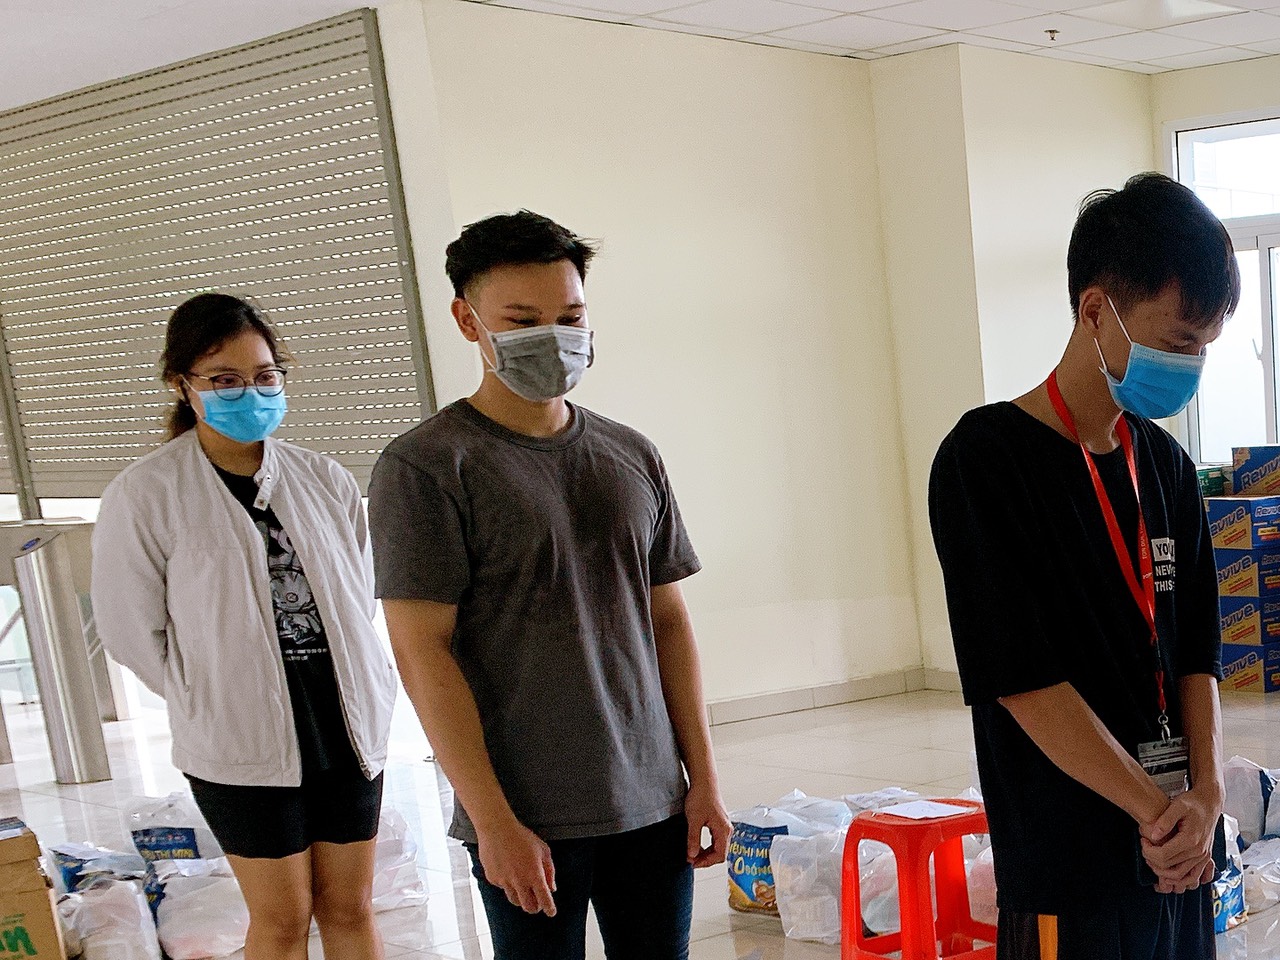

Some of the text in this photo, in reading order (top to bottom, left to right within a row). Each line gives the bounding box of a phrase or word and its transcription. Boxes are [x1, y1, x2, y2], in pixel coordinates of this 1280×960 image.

[1210, 506, 1245, 538] evive
[1218, 555, 1252, 584] evive
[1220, 603, 1255, 633] evive
[1222, 651, 1258, 680] evive
